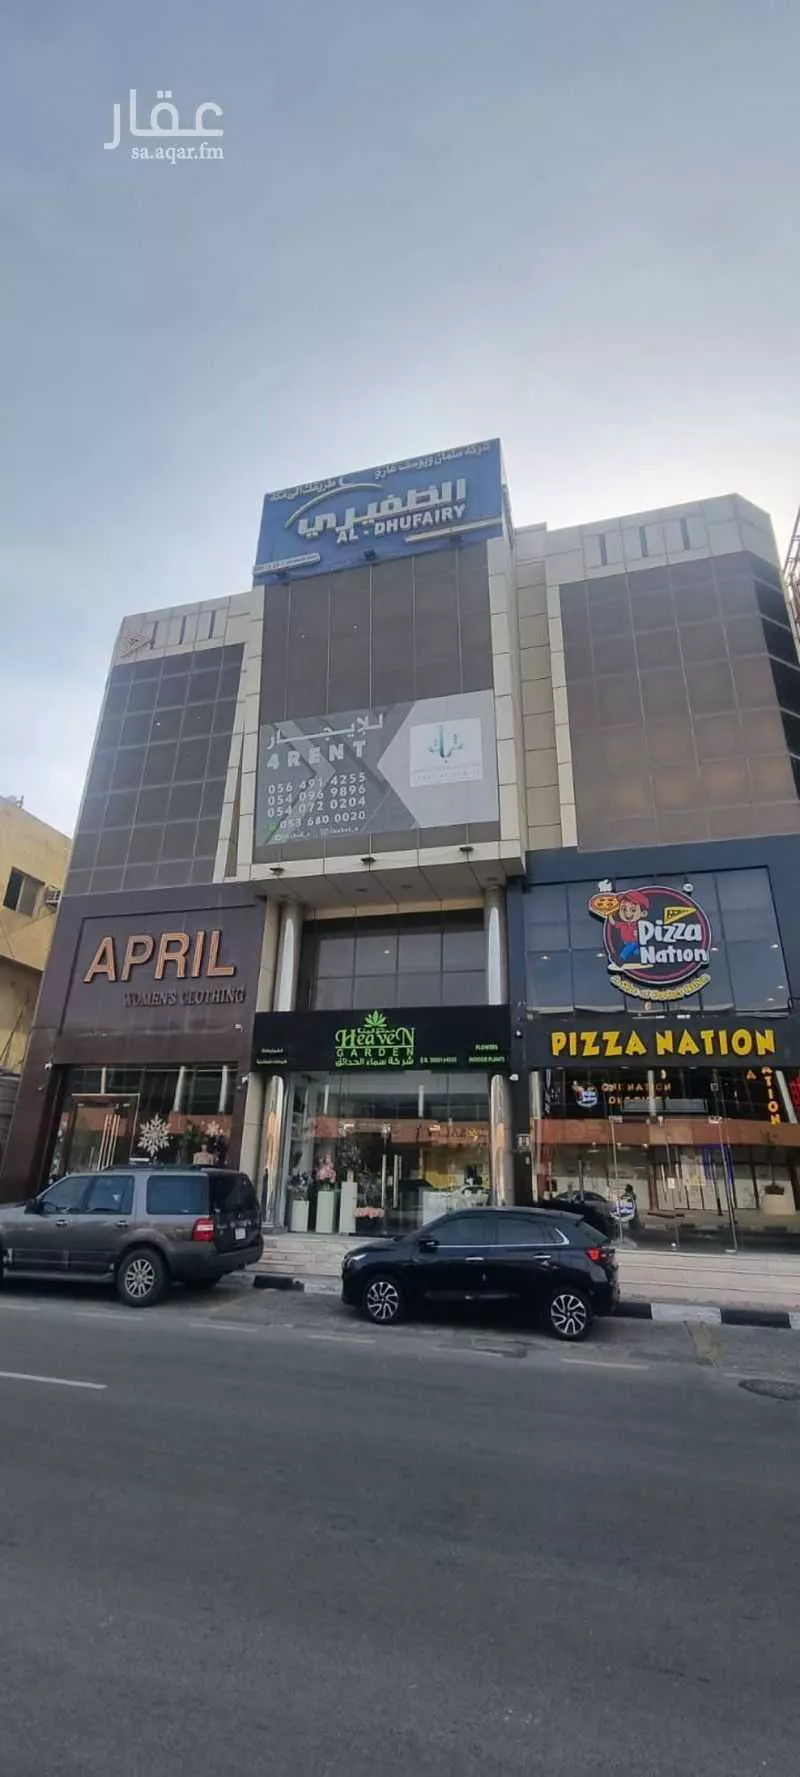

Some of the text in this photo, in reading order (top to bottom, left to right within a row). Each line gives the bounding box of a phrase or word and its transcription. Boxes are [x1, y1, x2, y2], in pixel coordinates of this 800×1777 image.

[298, 479, 466, 537] الضفيري
[336, 529, 359, 544] AL
[374, 504, 466, 535] DHUFAIRY
[267, 740, 367, 770] 4 RENT
[268, 772, 366, 794] 056 491 4255
[267, 784, 366, 805] 054 096 9896
[267, 796, 366, 818] 054 072 0204
[334, 810, 366, 823] 0020
[638, 919, 702, 945] Pizza
[82, 929, 236, 984] APRIL
[640, 945, 709, 964] Nation
[336, 1047, 414, 1057] GARDEN
[551, 1029, 777, 1057] PIZZA NATION
[388, 1055, 415, 1067] شركة
